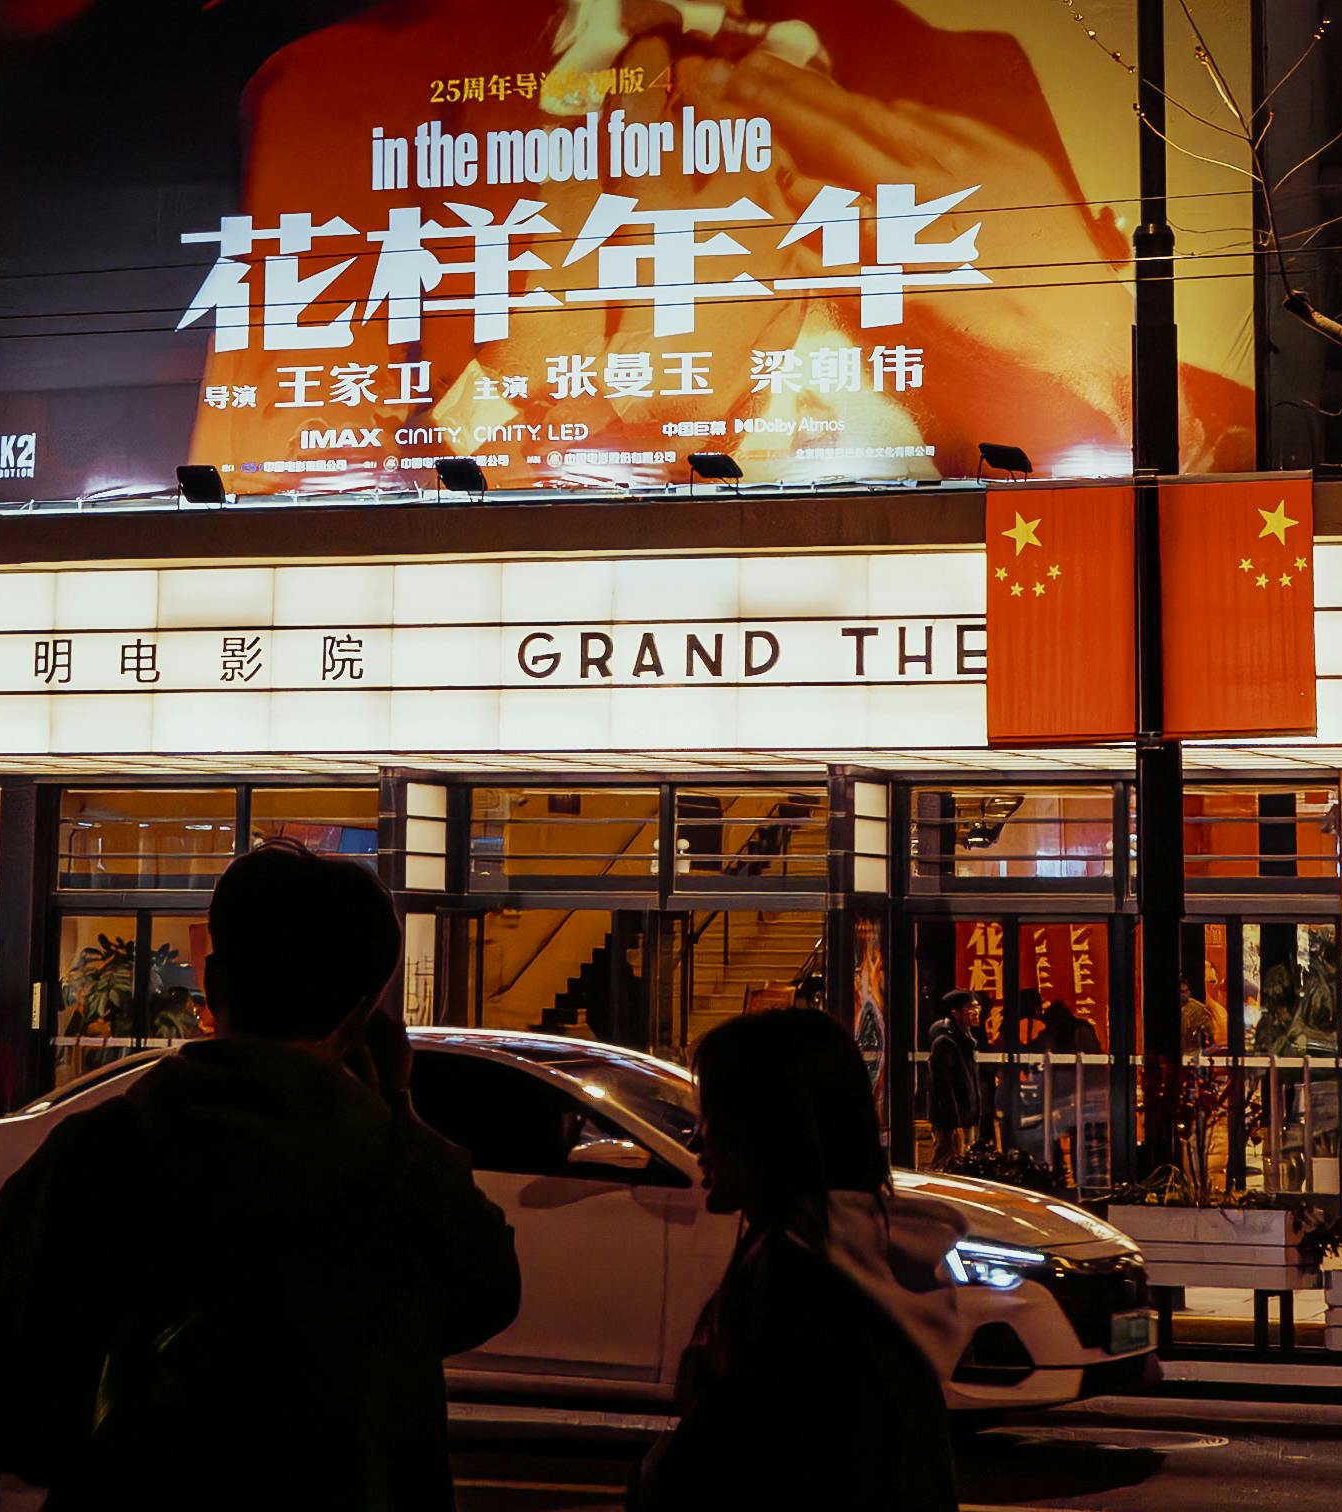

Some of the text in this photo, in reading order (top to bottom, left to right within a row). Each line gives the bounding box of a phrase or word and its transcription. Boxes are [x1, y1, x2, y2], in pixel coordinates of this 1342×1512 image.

[370, 105, 773, 191] in the mood for love
[173, 182, 995, 354] 花样年华
[204, 345, 926, 411] 导演 王家卫 主演 张曼玉 梁朝伟
[300, 427, 385, 450] IMAX
[547, 423, 590, 442] LED
[661, 420, 727, 438] 中国巨幕
[752, 418, 797, 436] Dolby
[797, 415, 845, 433] Atmos
[517, 630, 781, 679] GRAND
